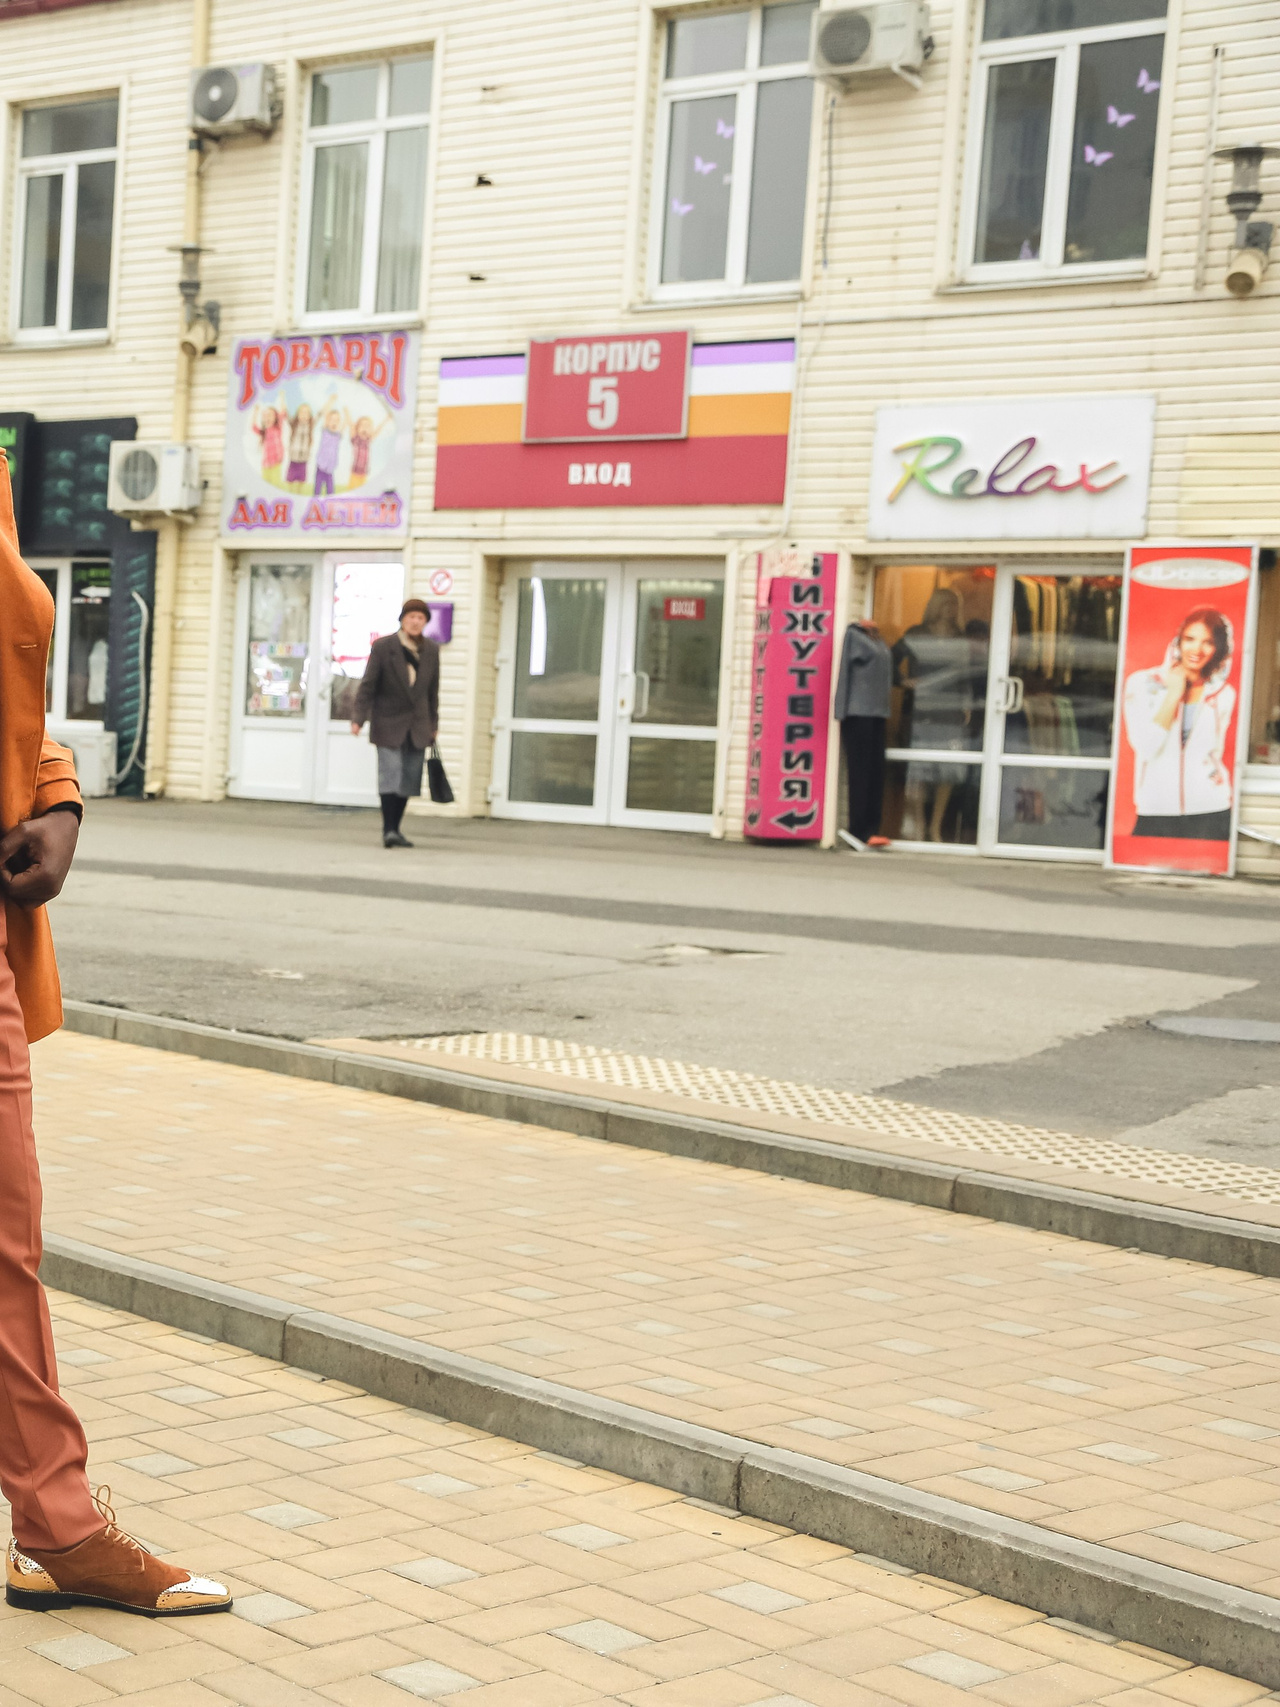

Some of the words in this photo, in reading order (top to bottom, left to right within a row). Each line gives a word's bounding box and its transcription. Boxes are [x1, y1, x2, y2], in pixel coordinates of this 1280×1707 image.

[237, 334, 407, 408] ТОВАРЫ
[553, 339, 662, 376] КОРПУС
[586, 376, 620, 430] 5
[568, 462, 632, 487] ВХОД
[887, 436, 1127, 504] Relax
[230, 501, 291, 527] ДЛЯ
[303, 496, 401, 527] ДЕТЕЙ
[670, 600, 697, 617] ВХОД
[748, 609, 772, 800] ЖУТЕРИЯ
[779, 556, 832, 800] ИЖУТЕРИЯ
